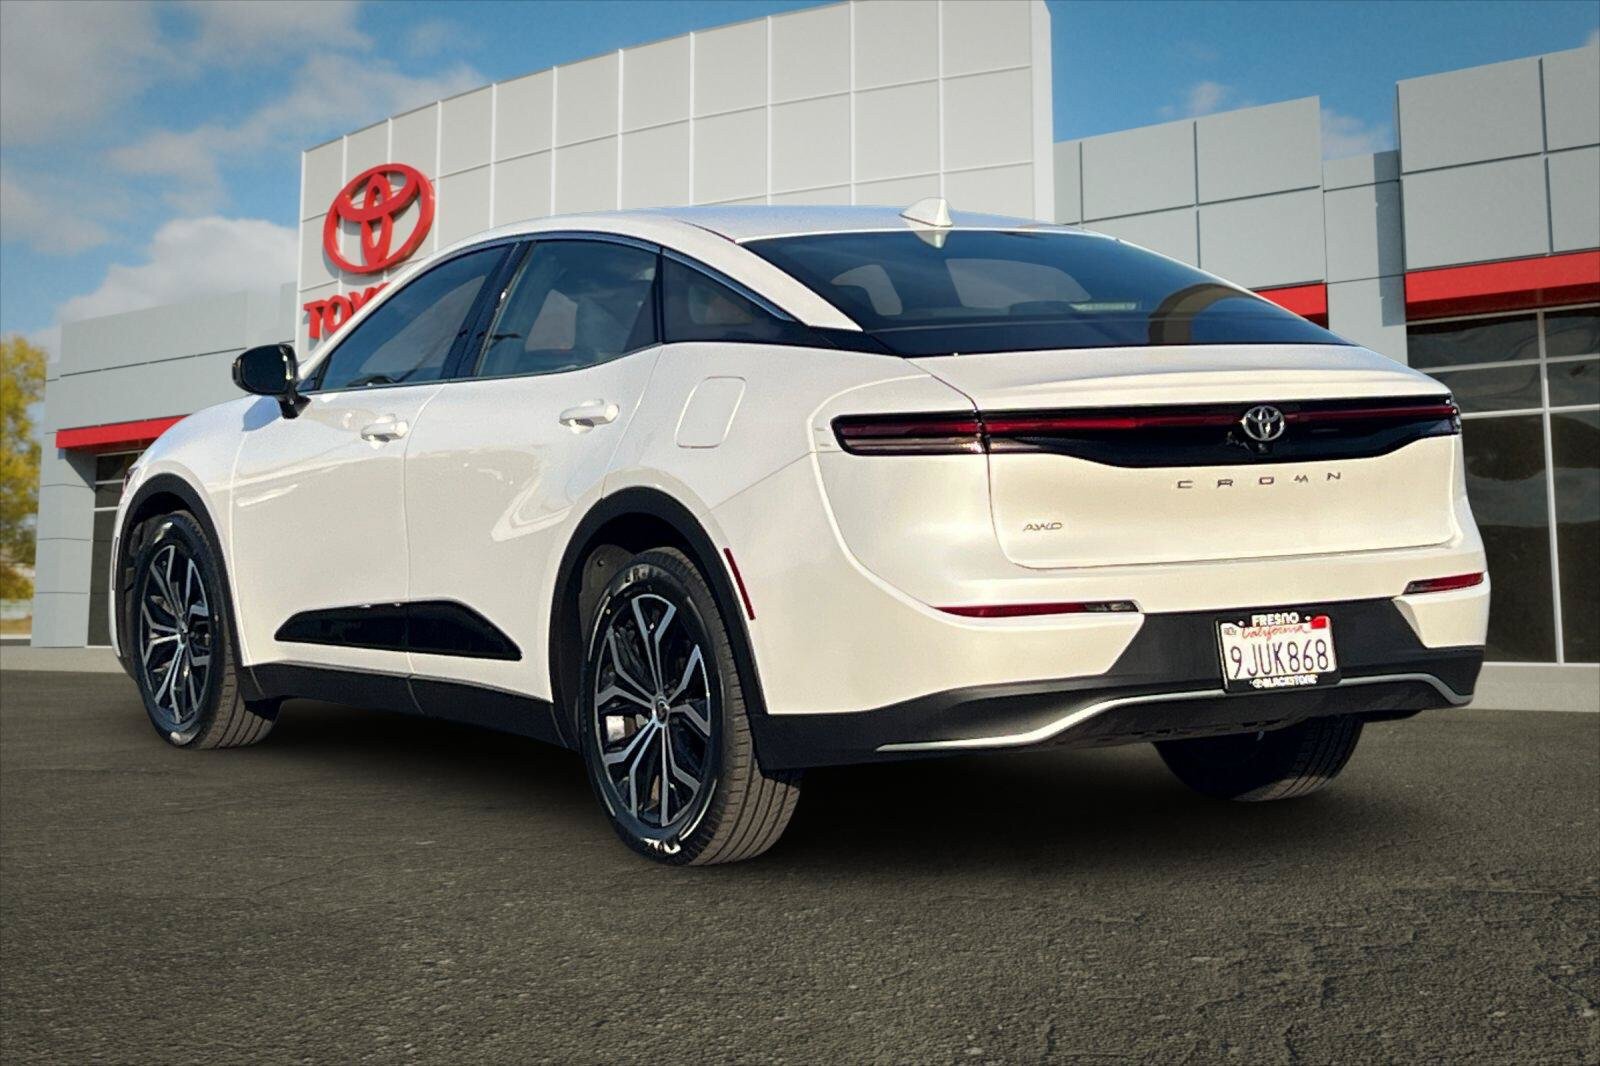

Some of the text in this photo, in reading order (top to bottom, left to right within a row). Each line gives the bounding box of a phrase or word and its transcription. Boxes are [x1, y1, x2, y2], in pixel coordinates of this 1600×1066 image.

[303, 282, 390, 339] TOY
[1177, 472, 1341, 489] CROWN
[1022, 522, 1063, 532] AWD
[1252, 612, 1299, 627] FRESNO
[1241, 624, 1310, 640] California
[1230, 638, 1328, 679] 9JUK868
